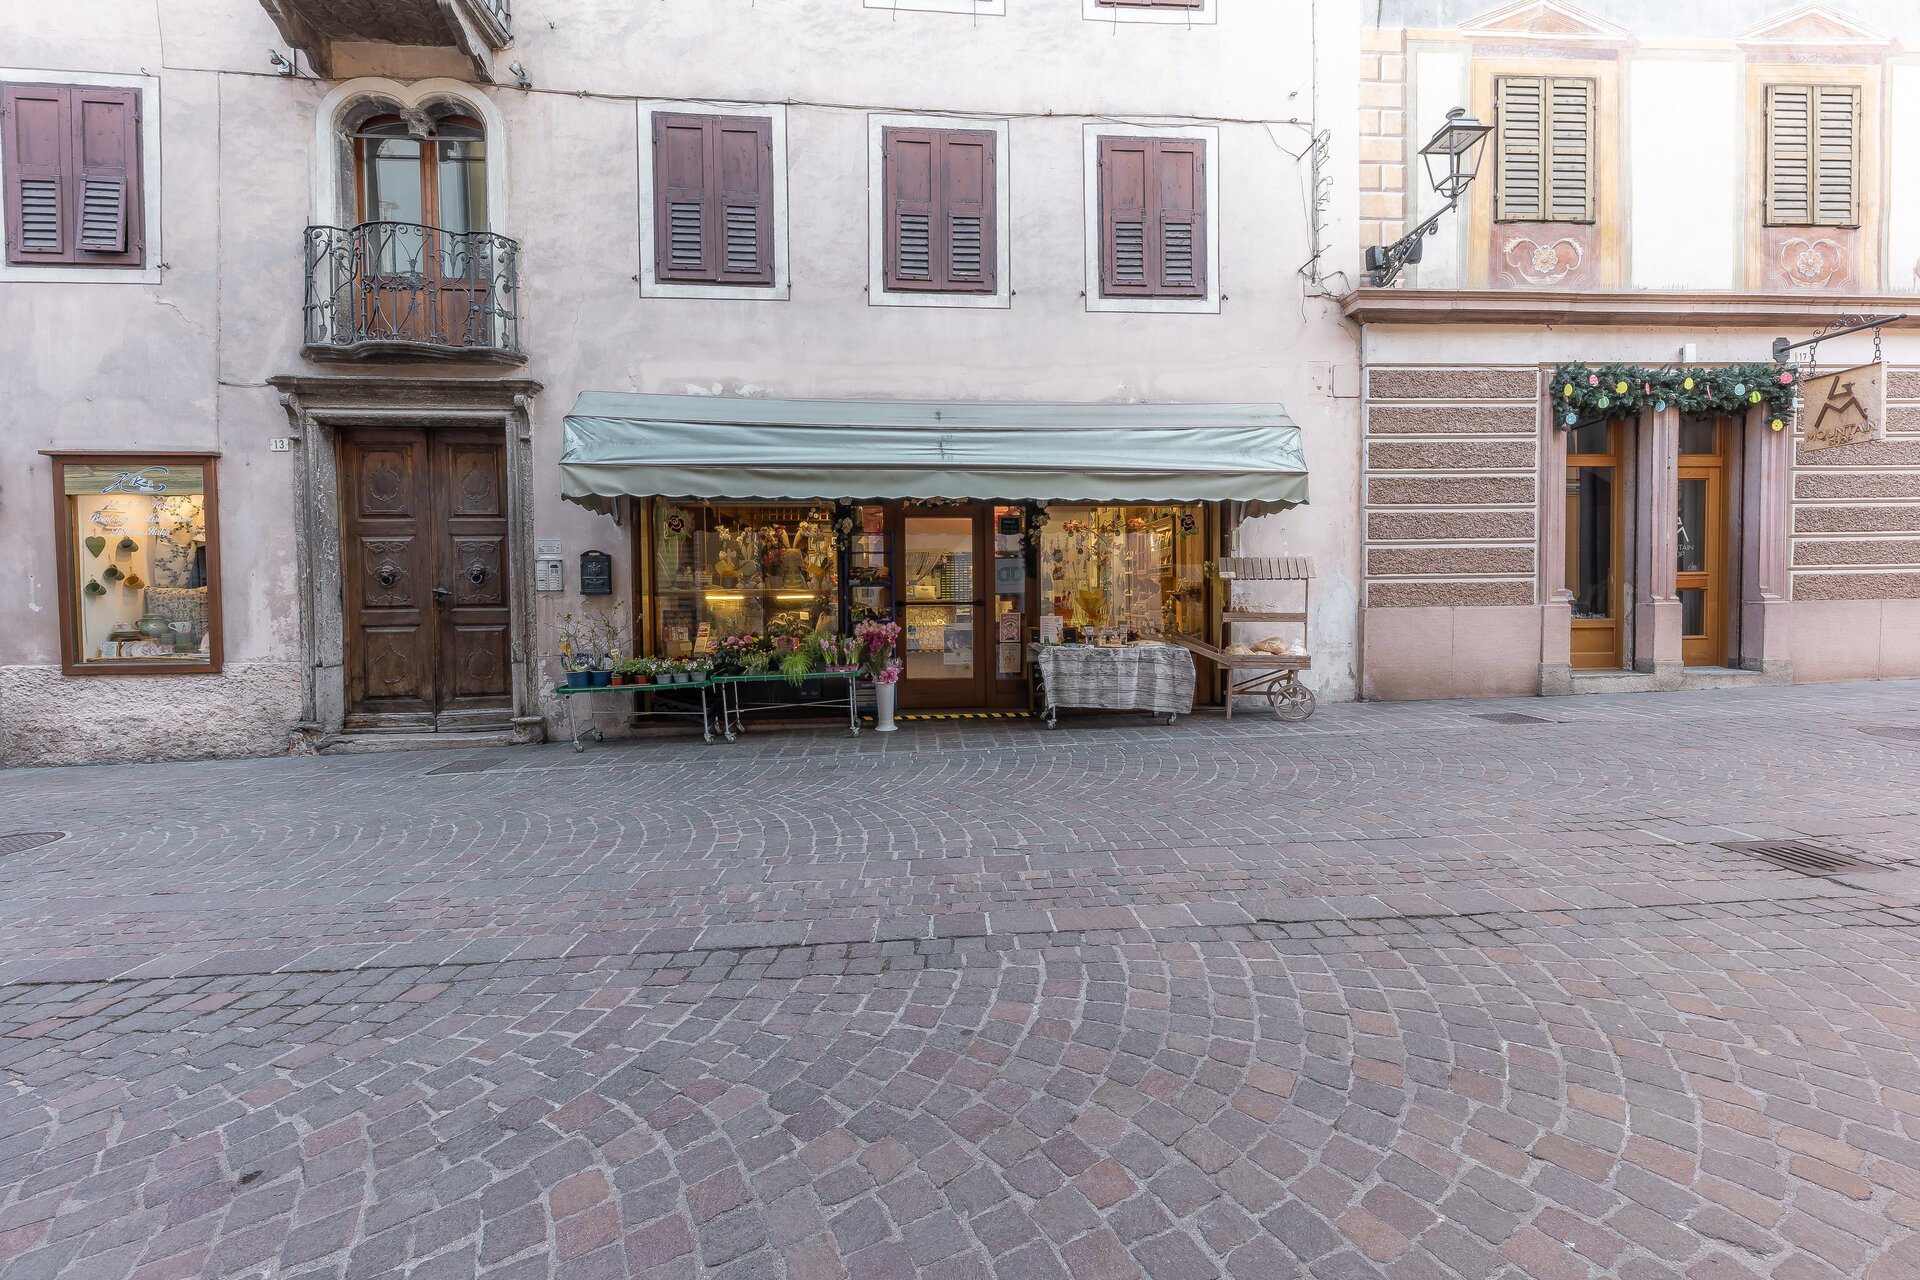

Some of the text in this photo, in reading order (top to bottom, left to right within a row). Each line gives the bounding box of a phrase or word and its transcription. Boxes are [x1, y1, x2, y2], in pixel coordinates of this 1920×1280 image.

[1799, 353, 1807, 361] 17
[1807, 420, 1878, 442] MOUNTAIN
[274, 439, 285, 450] 13
[1828, 435, 1854, 446] SHOP
